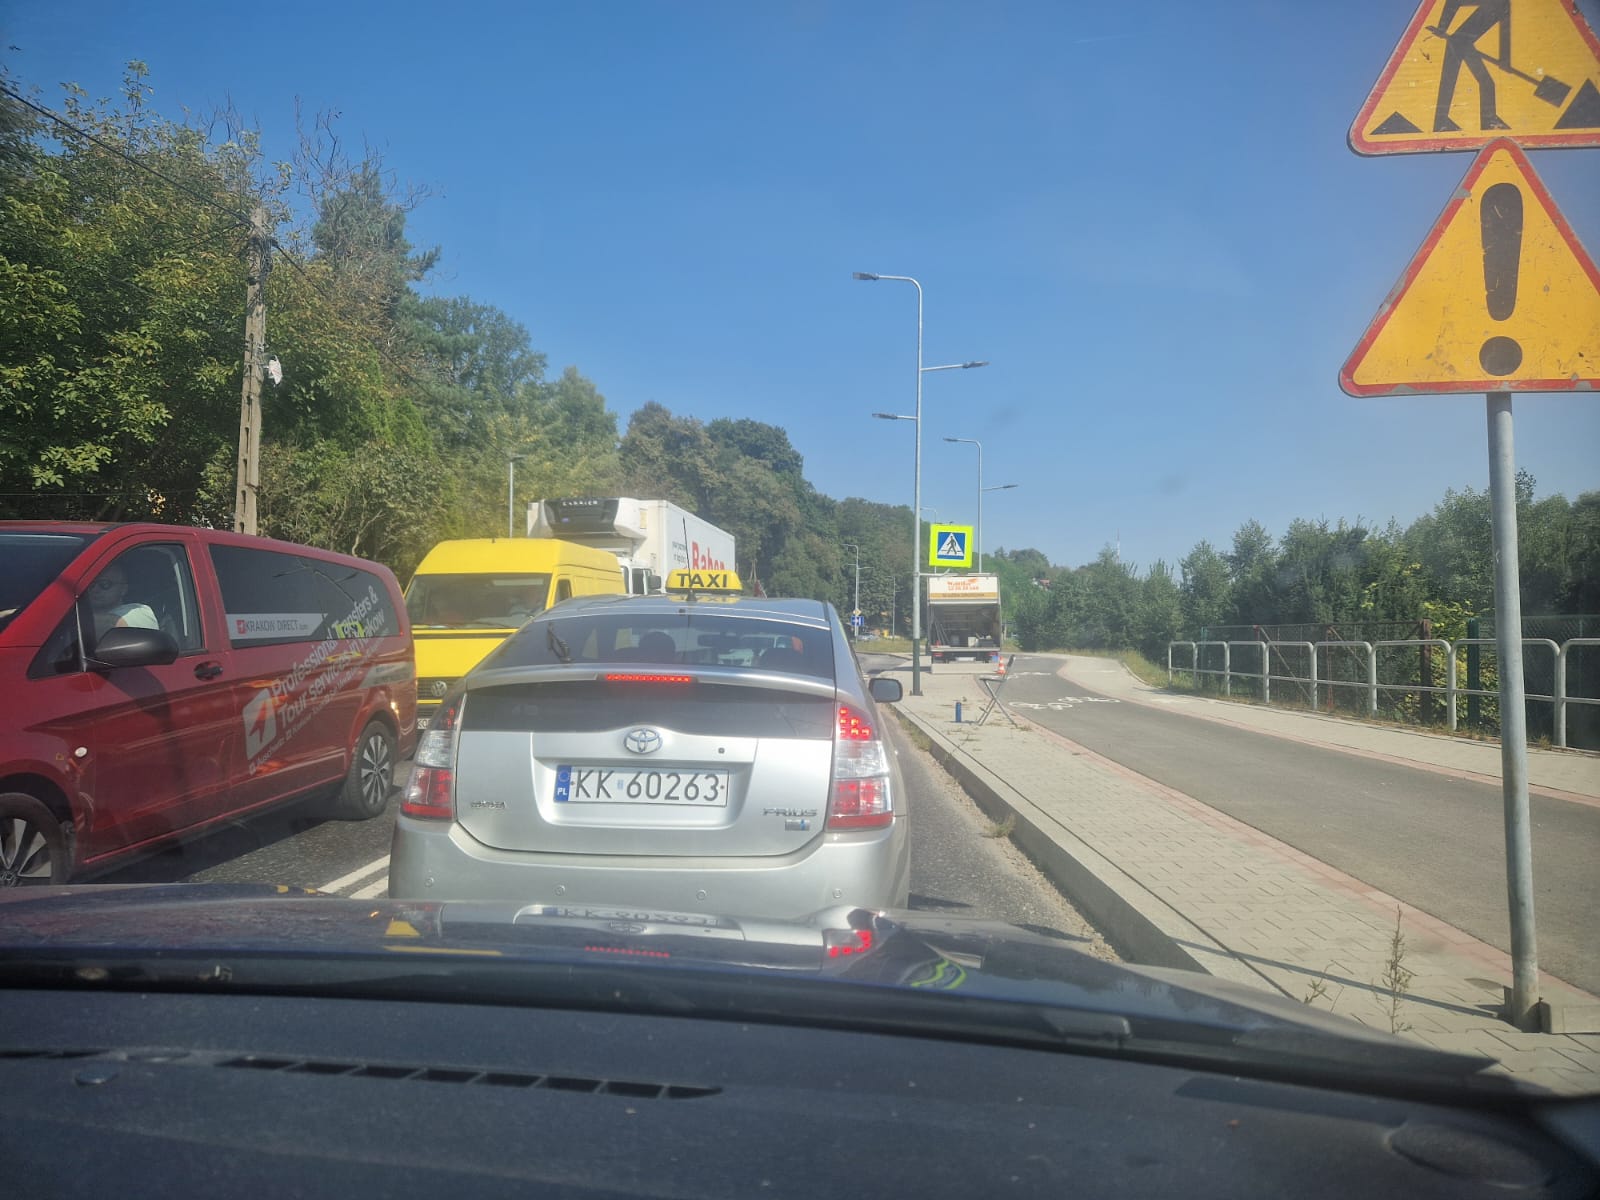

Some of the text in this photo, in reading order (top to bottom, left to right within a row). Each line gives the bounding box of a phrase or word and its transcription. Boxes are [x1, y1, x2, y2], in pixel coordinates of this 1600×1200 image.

[676, 573, 728, 588] TAXI
[277, 619, 299, 631] DIRECT
[271, 628, 338, 704] Professional
[368, 584, 379, 605] &
[277, 691, 308, 728] Tour
[309, 651, 352, 698] services
[346, 637, 361, 656] in
[557, 787, 568, 796] PL
[575, 769, 720, 801] KK 60263
